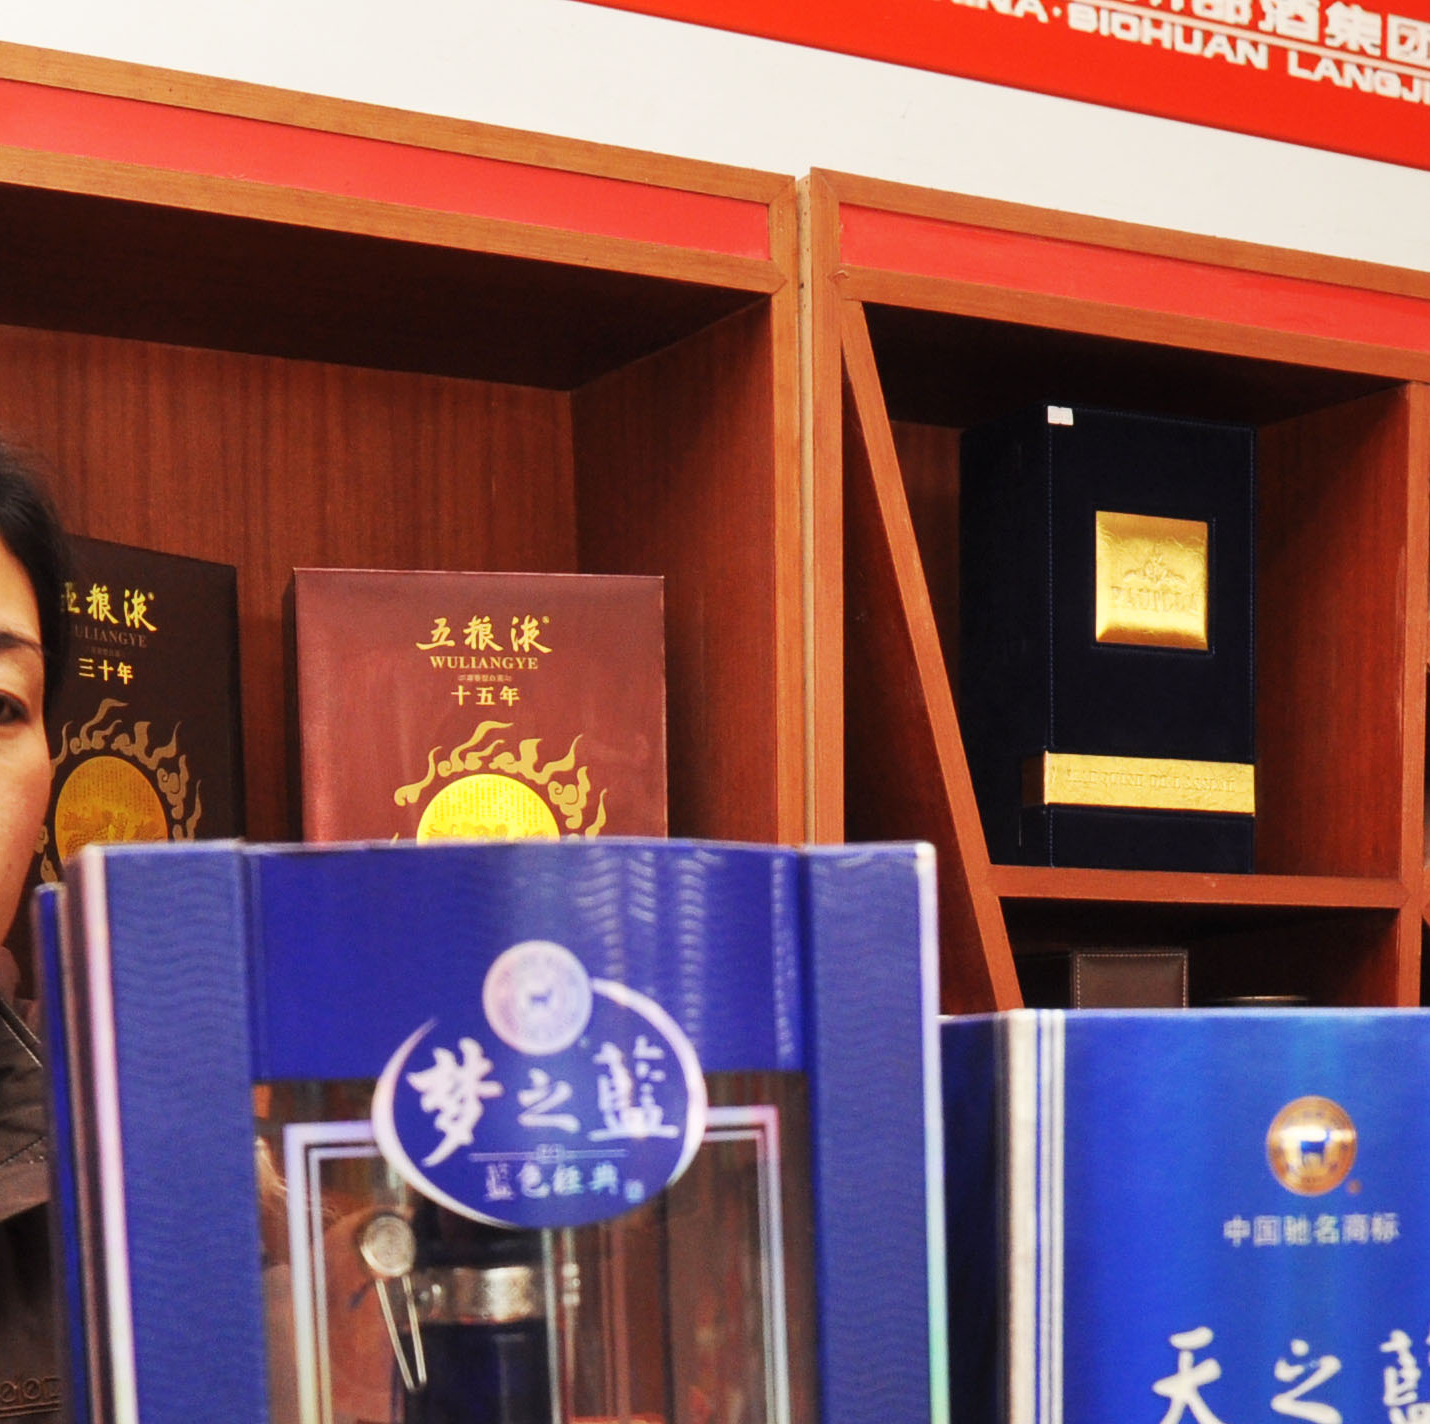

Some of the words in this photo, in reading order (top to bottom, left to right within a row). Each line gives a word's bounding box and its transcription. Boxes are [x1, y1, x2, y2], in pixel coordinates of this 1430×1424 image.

[74, 624, 148, 649] ULIANGYE
[415, 614, 553, 653] 五粮液
[78, 658, 134, 685] 三十年
[429, 655, 539, 670] WULIANGYE
[451, 684, 520, 707] 十五年
[1223, 1213, 1401, 1247] 中国驰名商标
